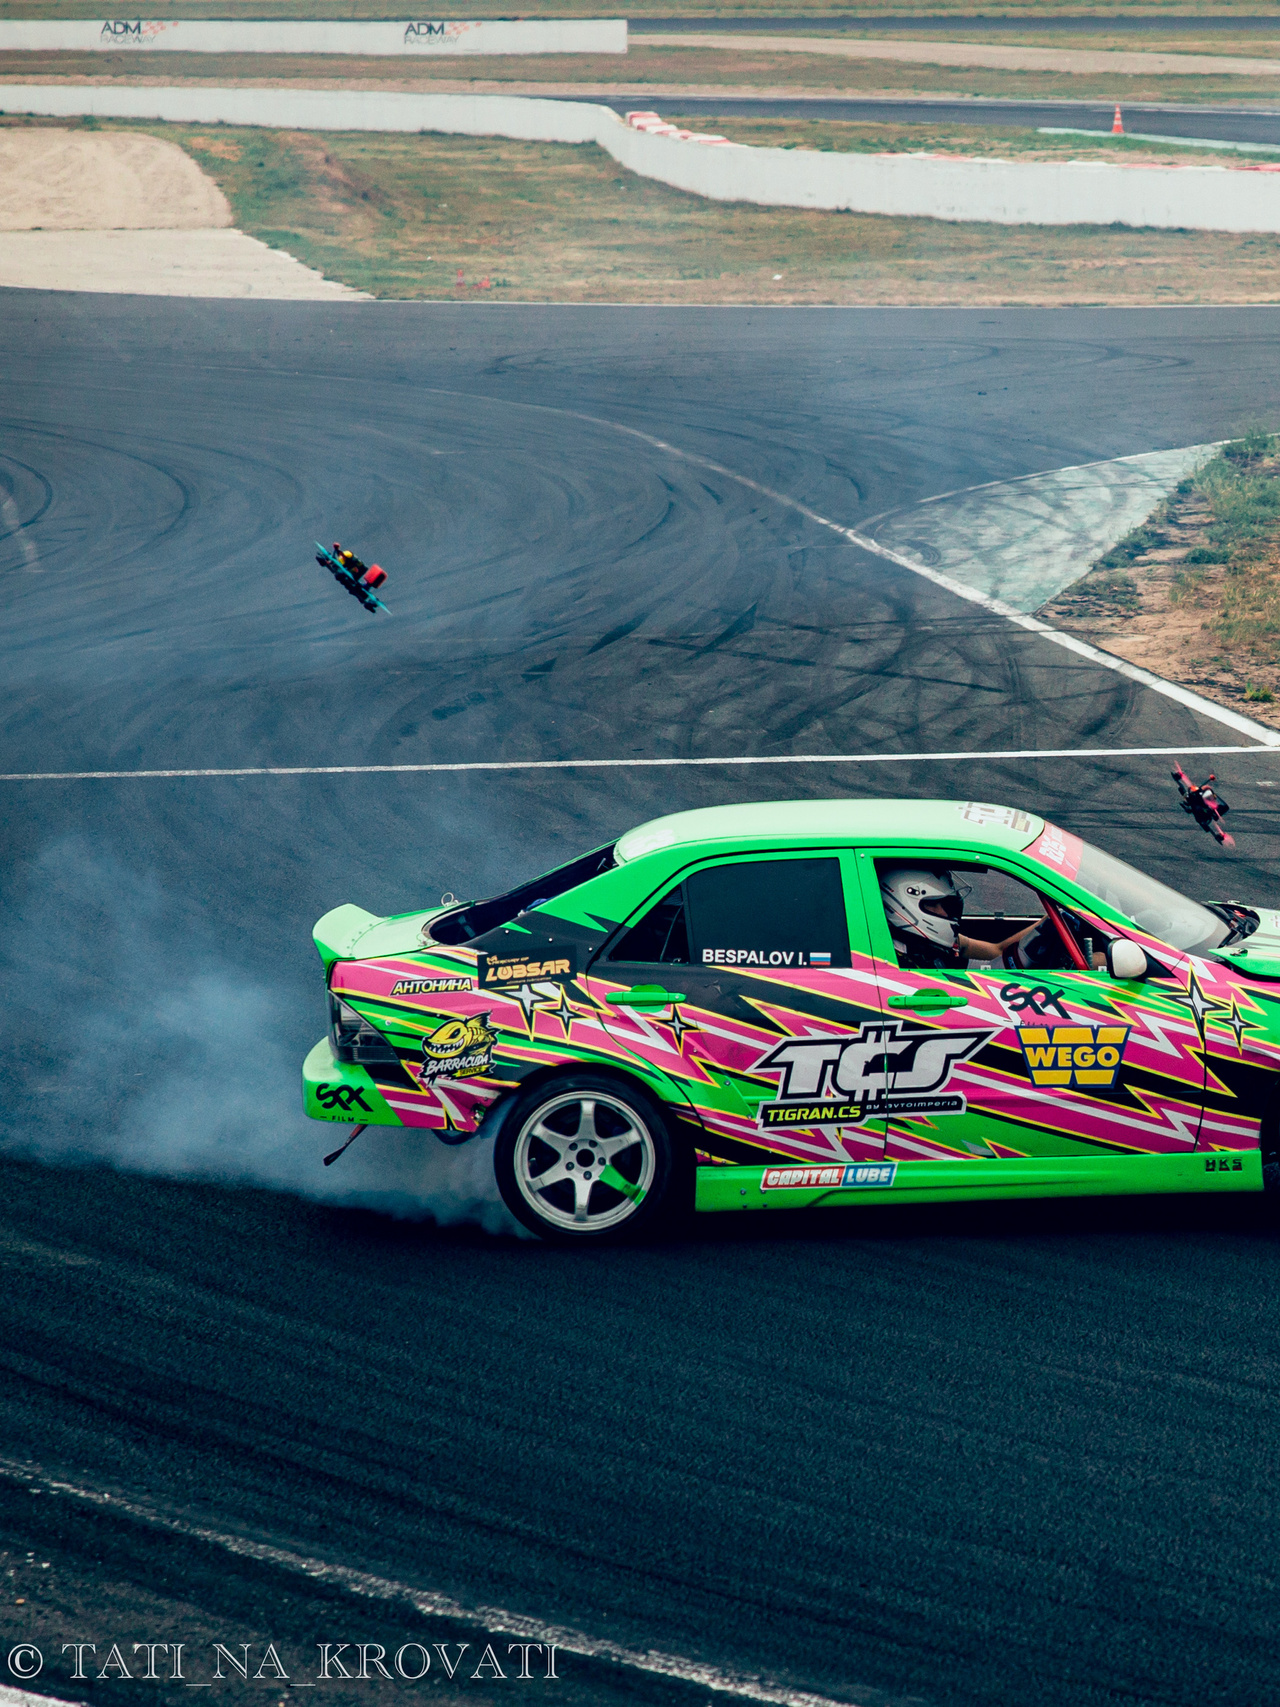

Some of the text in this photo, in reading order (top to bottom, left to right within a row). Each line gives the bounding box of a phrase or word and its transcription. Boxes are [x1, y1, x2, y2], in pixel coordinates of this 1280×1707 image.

[101, 21, 141, 34] ADM
[405, 22, 445, 35] ADM
[702, 949, 807, 965] BESPALOV I.
[485, 959, 570, 982] LUBSAR
[393, 979, 471, 994] АНТОНИНА
[424, 1054, 489, 1075] BARRACUDA
[1025, 1046, 1120, 1067] WEGO
[768, 1106, 861, 1122] TIGRAN.CS
[1205, 1158, 1242, 1171] HKS
[766, 1167, 891, 1186] CAPITAL LUBE
